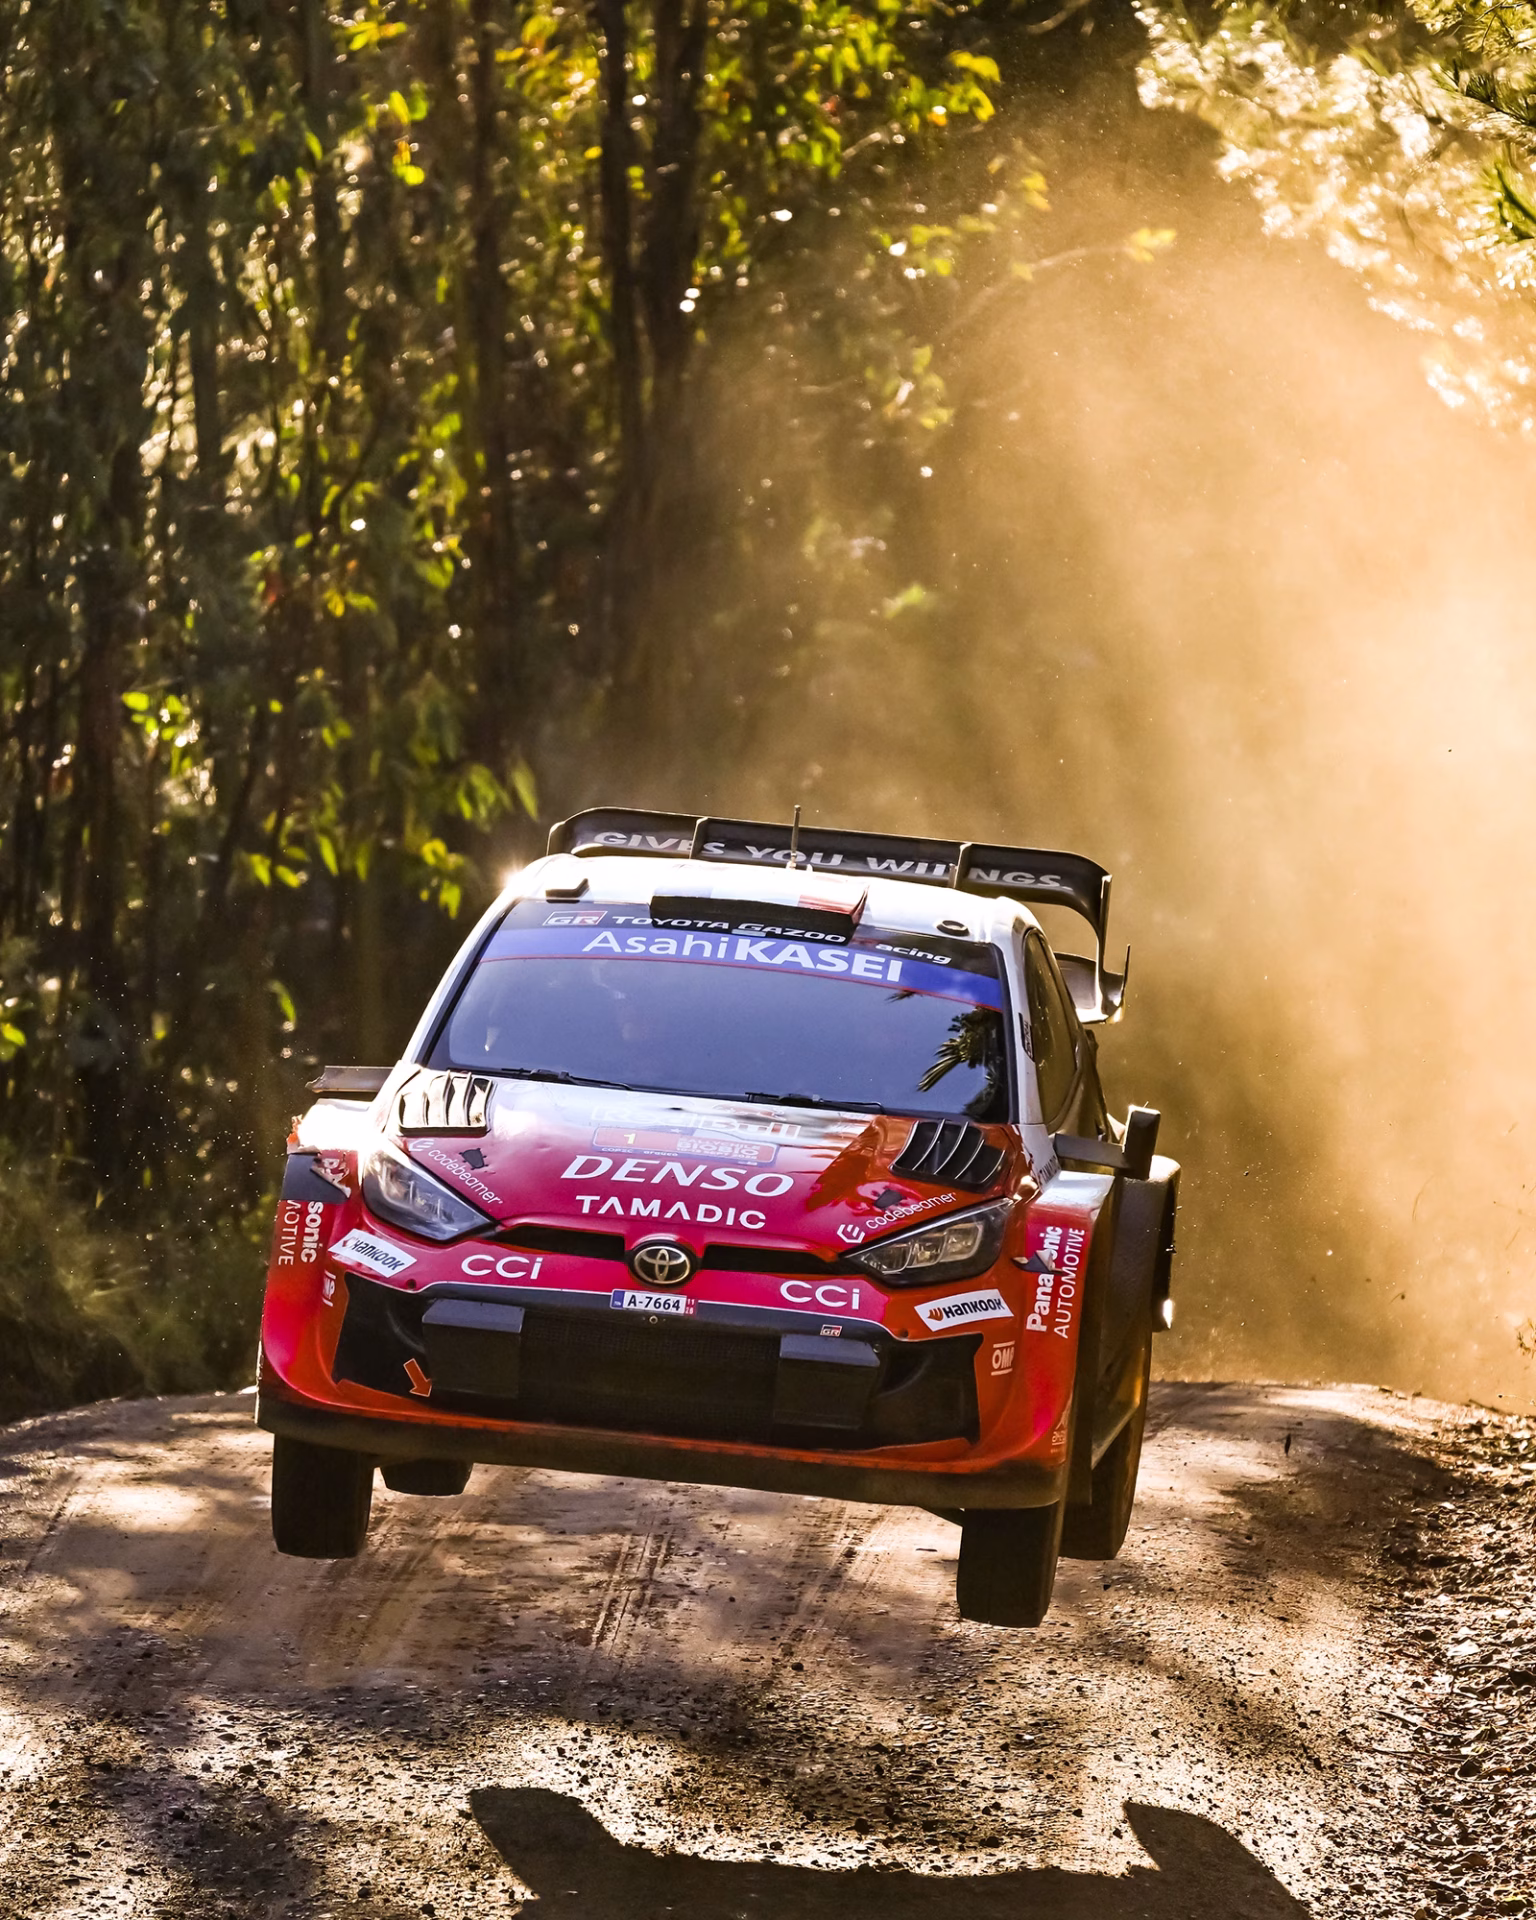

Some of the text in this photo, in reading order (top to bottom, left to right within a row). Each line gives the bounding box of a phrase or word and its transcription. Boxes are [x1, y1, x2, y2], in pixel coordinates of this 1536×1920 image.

[594, 831, 1073, 891] GIVES YOU WIINGS.
[546, 914, 952, 965] GR TOYOTA GAZOO acing
[623, 1133, 636, 1144] 1
[428, 1149, 500, 1204] codebeamer
[560, 1155, 795, 1197] DENSO
[575, 1195, 766, 1230] TAMADIC
[866, 1192, 957, 1229] codebeamer
[1026, 1226, 1063, 1332] Pananic
[1053, 1228, 1086, 1339] AUTOMOTIVE
[627, 1294, 681, 1312] A-7664
[991, 1346, 1015, 1370] OMP
